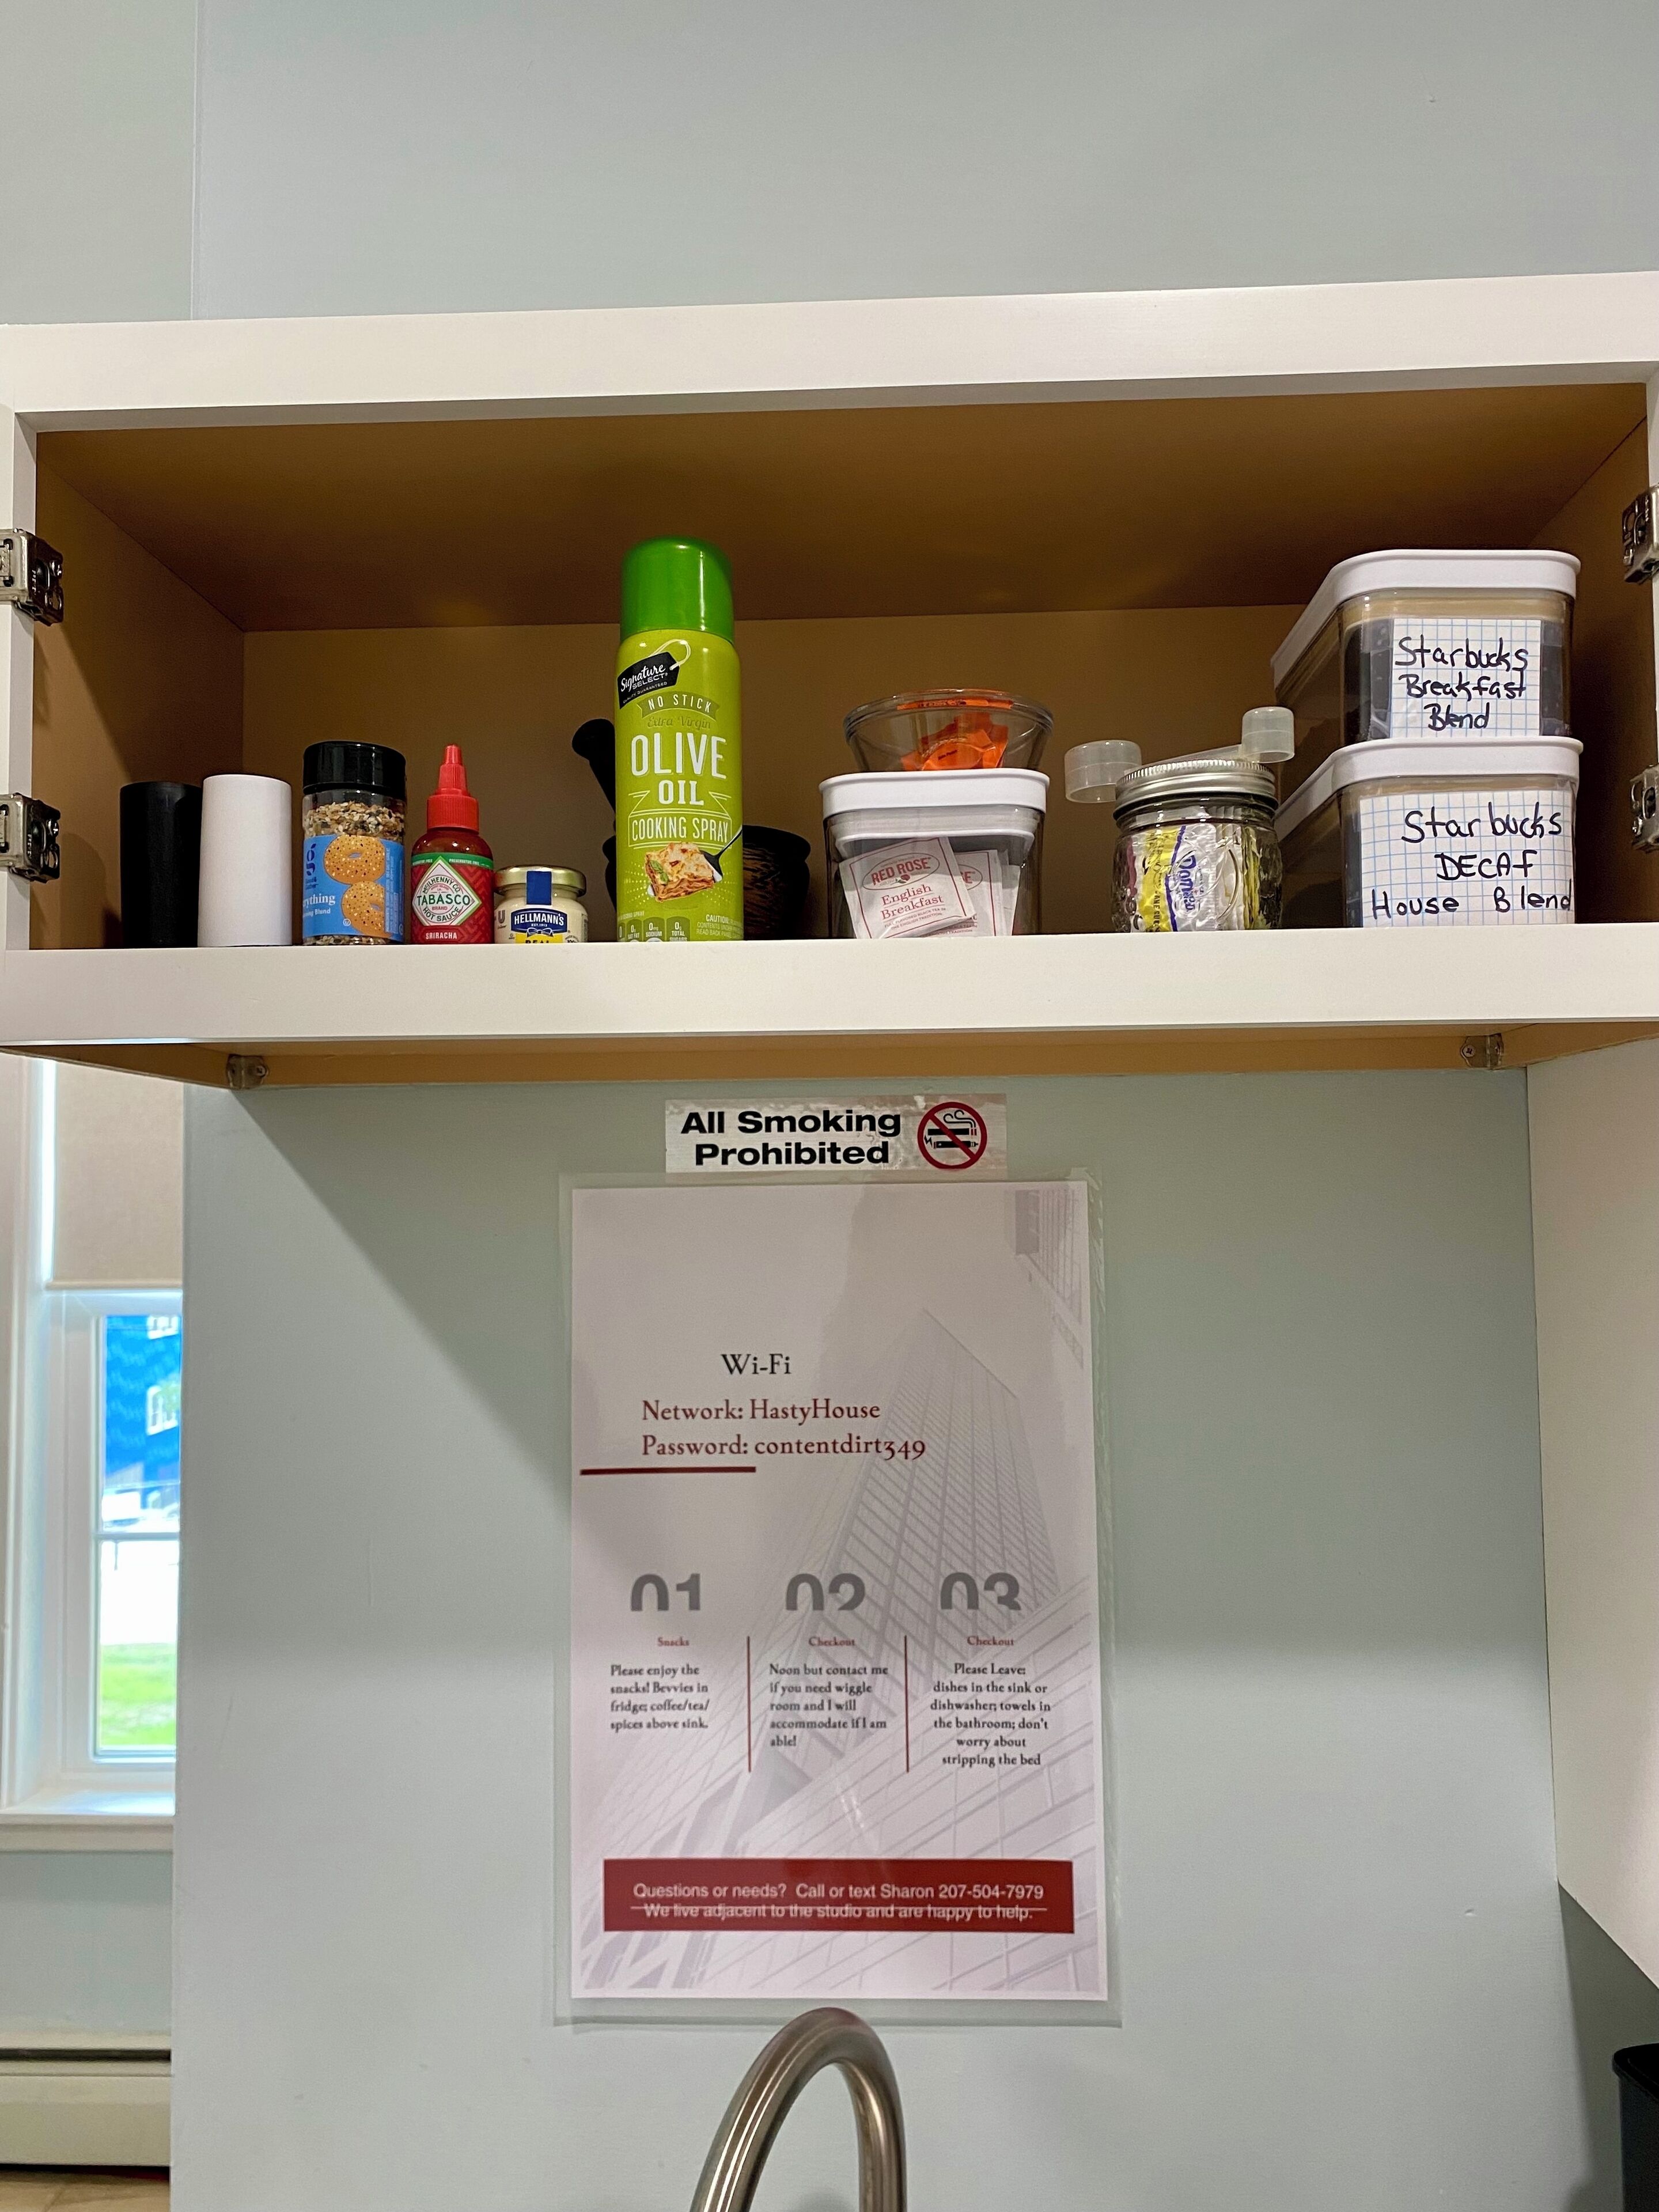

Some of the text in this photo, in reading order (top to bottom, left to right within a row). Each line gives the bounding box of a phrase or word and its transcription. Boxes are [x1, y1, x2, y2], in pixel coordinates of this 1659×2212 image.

[1395, 634, 1529, 672] Starbucks
[621, 664, 666, 692] Signature
[1398, 669, 1527, 702] Breakfast
[648, 694, 711, 713] NO STICK
[647, 716, 711, 730] Extra Virgin
[1423, 702, 1490, 731] Blend
[631, 732, 727, 779] OLIVE
[658, 780, 704, 805] OIL
[632, 816, 728, 843] COOKING SPRAY
[1401, 801, 1562, 843] Starbucks
[871, 866, 895, 885] RED
[896, 857, 931, 874] ROSE
[417, 893, 470, 906] TABASCO
[881, 884, 932, 906] English
[1372, 878, 1572, 919] House Blend
[423, 907, 461, 922] HOT SAUCE
[881, 895, 944, 919] Breakfast
[514, 913, 564, 926] HELLMANN'S
[426, 932, 457, 940] SRIRACHA
[681, 1109, 902, 1137] All Smoking
[695, 1141, 889, 1165] Prohibited
[721, 1354, 791, 1375] Wi-Fi
[642, 1398, 881, 1426] Network: HastyHouse
[642, 1432, 926, 1461] Password: contentdirt349
[658, 1637, 690, 1646] Snacks
[808, 1637, 855, 1646] Checkout
[967, 1635, 1014, 1646] Checkout
[611, 1664, 700, 1678] Please enjoy the
[770, 1664, 888, 1675] Noon but contact me
[955, 1663, 987, 1675] Please
[611, 1681, 708, 1694] snacks! Bevvies in
[770, 1681, 872, 1696] if you need wiggle
[933, 1681, 968, 1692] dishes
[971, 1682, 983, 1692] in
[986, 1681, 1004, 1692] the
[1007, 1681, 1031, 1692] sink
[650, 1699, 710, 1711] coffee/tea/
[770, 1699, 856, 1711] room and I will
[1000, 1700, 1036, 1711] towels
[1040, 1701, 1051, 1711] in
[611, 1716, 709, 1733] spices above sink.
[770, 1717, 848, 1729] accommodate
[851, 1717, 862, 1728] if
[870, 1721, 887, 1729] am
[934, 1716, 1048, 1730] the bathroom; don't
[956, 1736, 1026, 1751] worry about
[942, 1753, 1041, 1768] stripping the bed
[633, 1883, 1044, 1900] Questions or needs? Call or text Sharon 207-504-7979
[644, 1903, 1033, 1922] We live adjacent to the studio and are happy to help.
